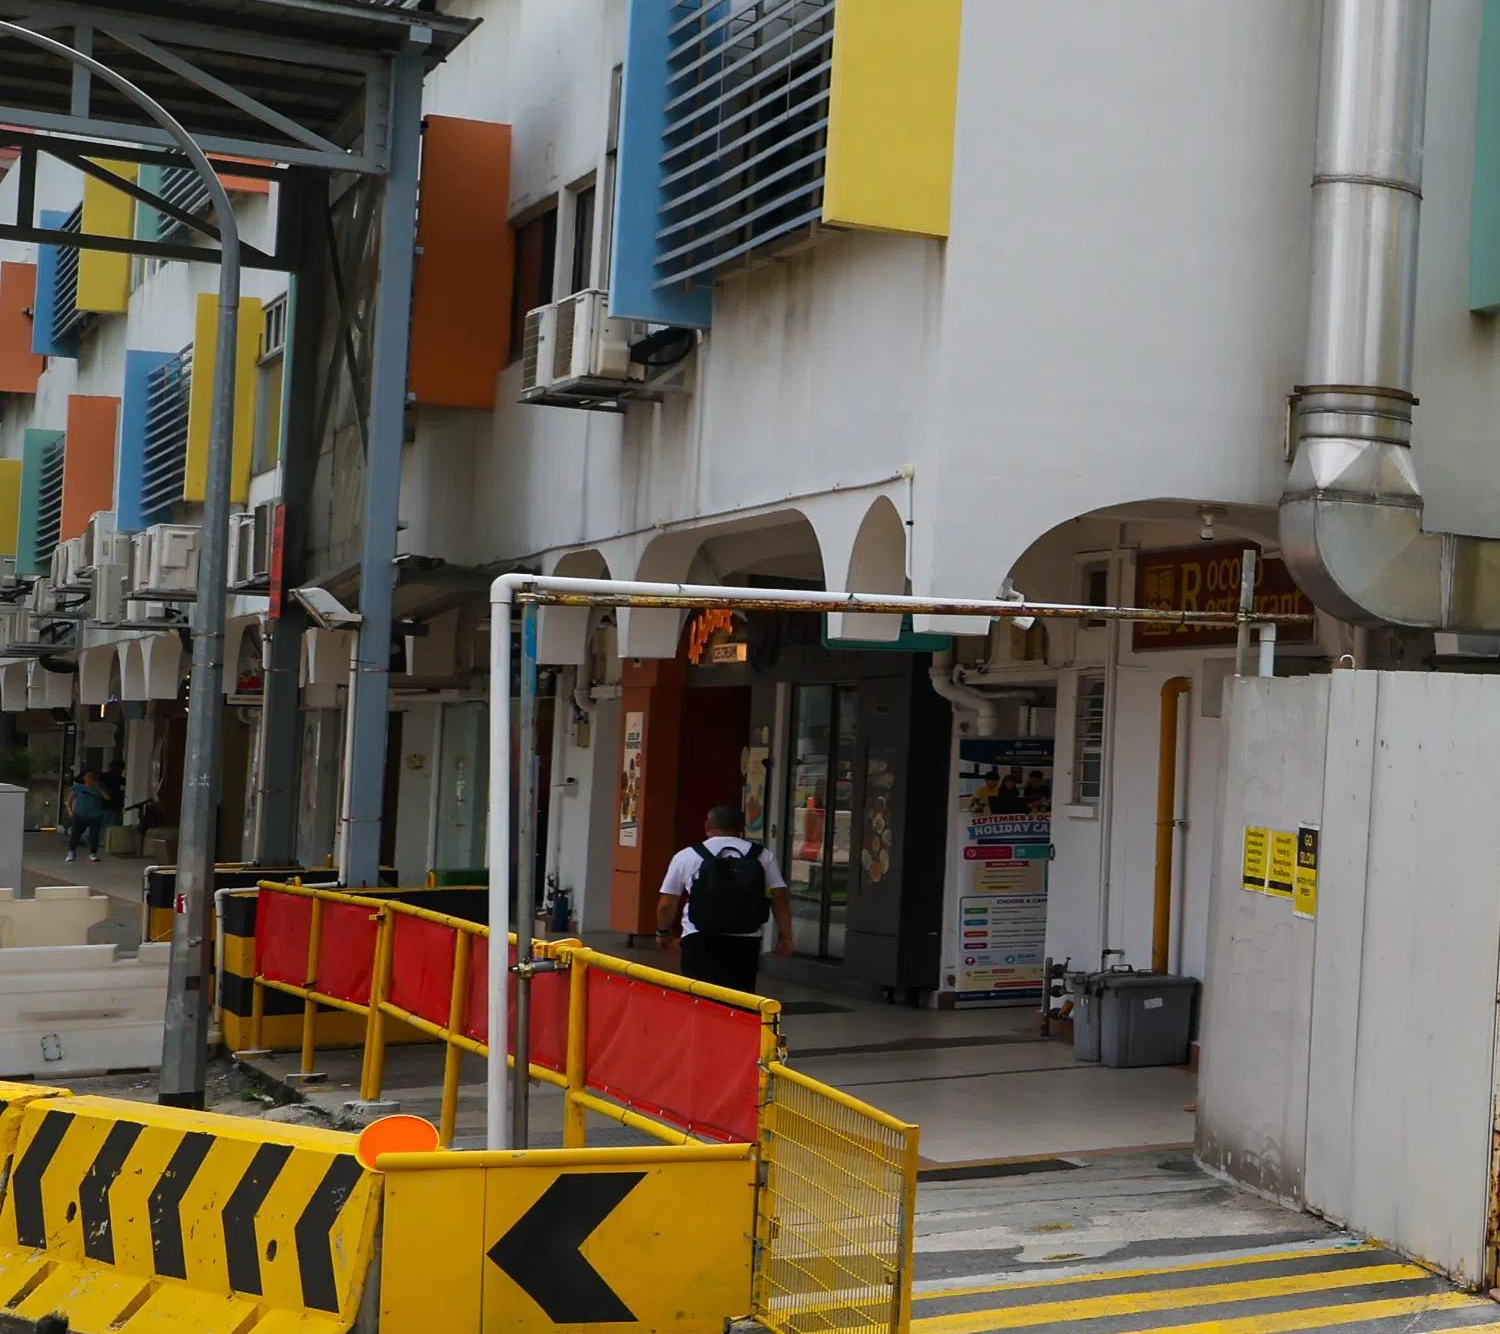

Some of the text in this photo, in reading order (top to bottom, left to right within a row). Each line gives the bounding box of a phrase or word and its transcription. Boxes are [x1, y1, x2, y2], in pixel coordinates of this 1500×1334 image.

[971, 815, 1026, 825] SEPTEMBER
[975, 824, 1031, 836] HOLIDAY
[1304, 834, 1313, 847] GO
